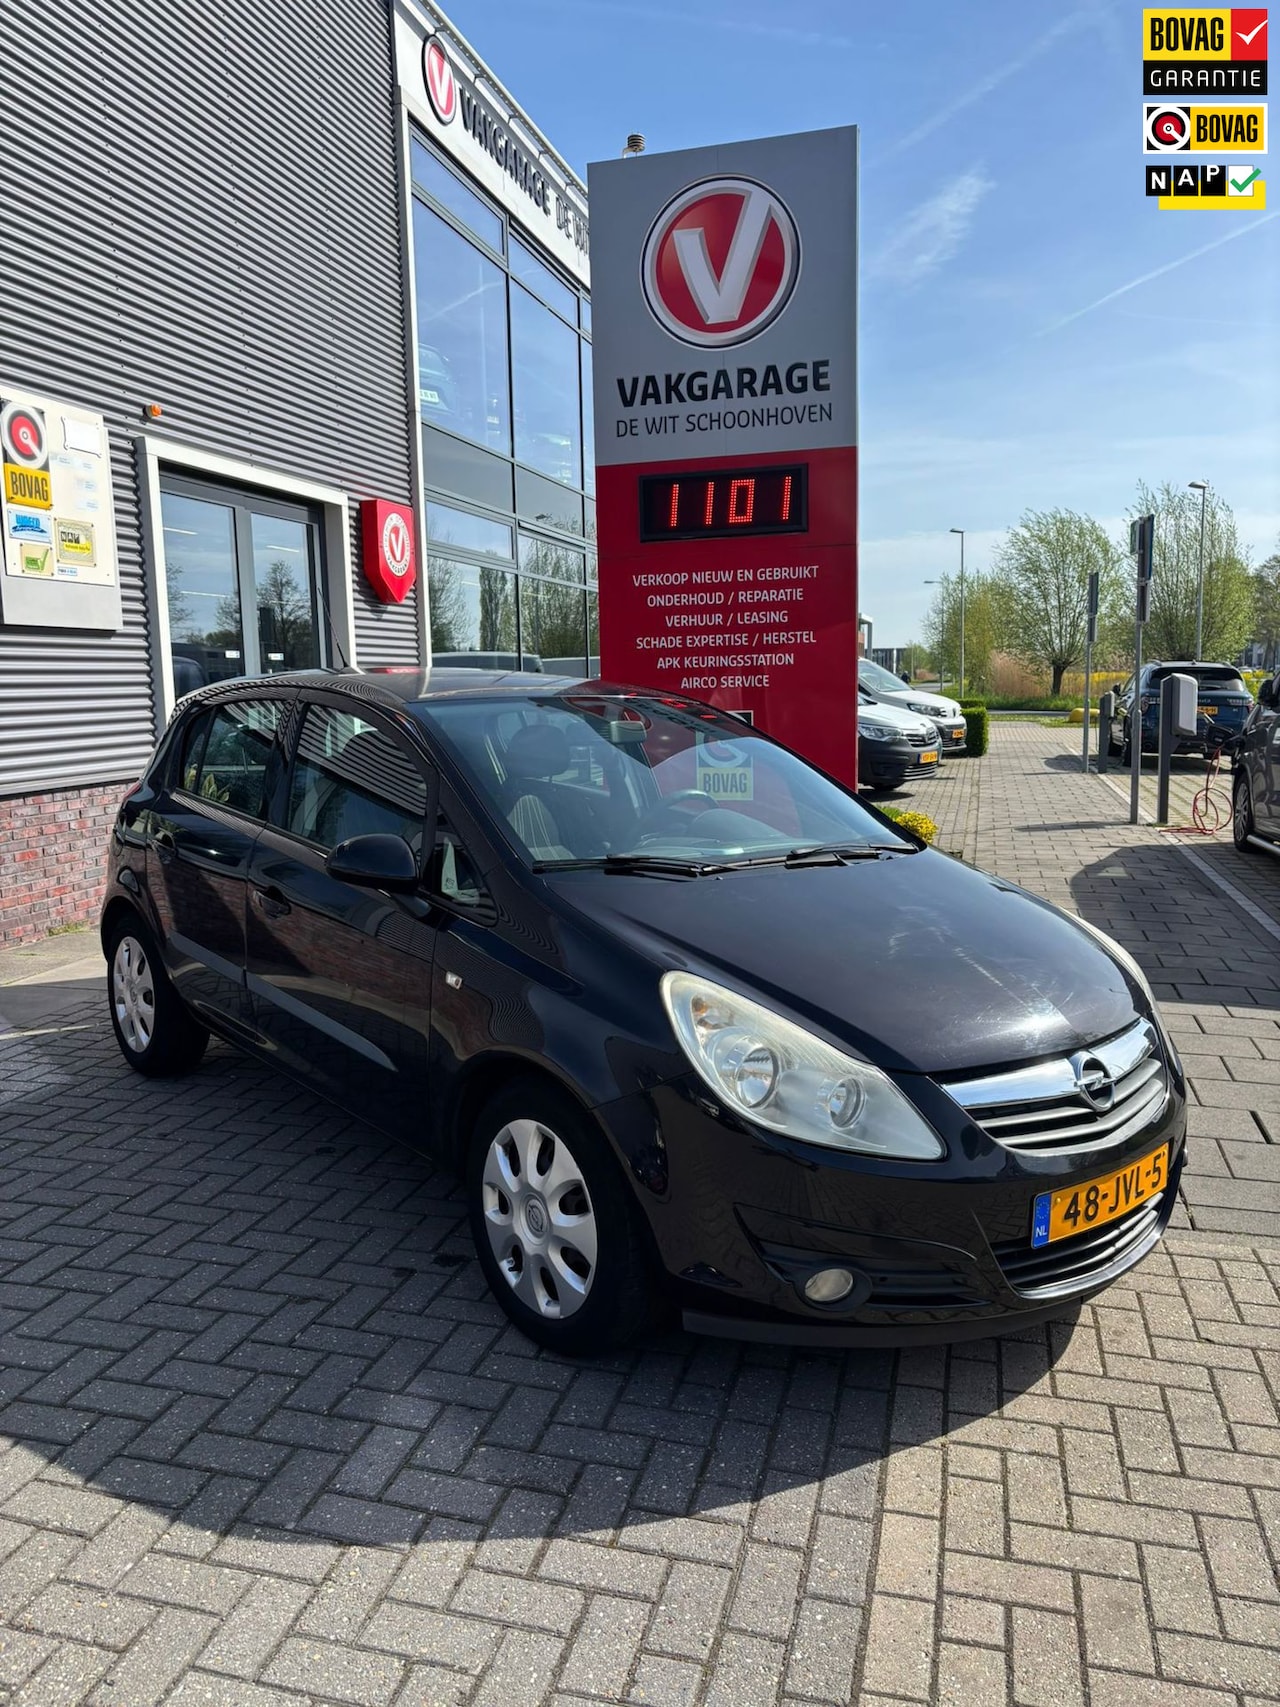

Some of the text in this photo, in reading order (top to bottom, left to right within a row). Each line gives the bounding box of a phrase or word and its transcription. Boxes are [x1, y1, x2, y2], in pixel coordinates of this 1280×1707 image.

[458, 85, 551, 216] VAKGARAGE
[555, 194, 572, 240] DE
[617, 360, 831, 408] VAKGARAGE
[616, 403, 832, 437] DE WIT SCHOONHOVEN
[10, 471, 49, 501] BOVAG
[633, 565, 819, 587] VERKOOP NIEUW EN GEBRUIKT
[647, 588, 804, 607] ONDERHOUD / REPARATIE
[665, 610, 789, 627] VERHUUR / LEASING
[636, 631, 817, 649] SCHADE EXPERTISE / HERSTEL
[657, 653, 795, 669] APK KEURINGSSTATION
[681, 675, 770, 689] AIRCO SERVICE
[702, 772, 748, 794] BOVAG
[1063, 1154, 1163, 1228] 48-JVL-5
[1035, 1225, 1048, 1238] NL
